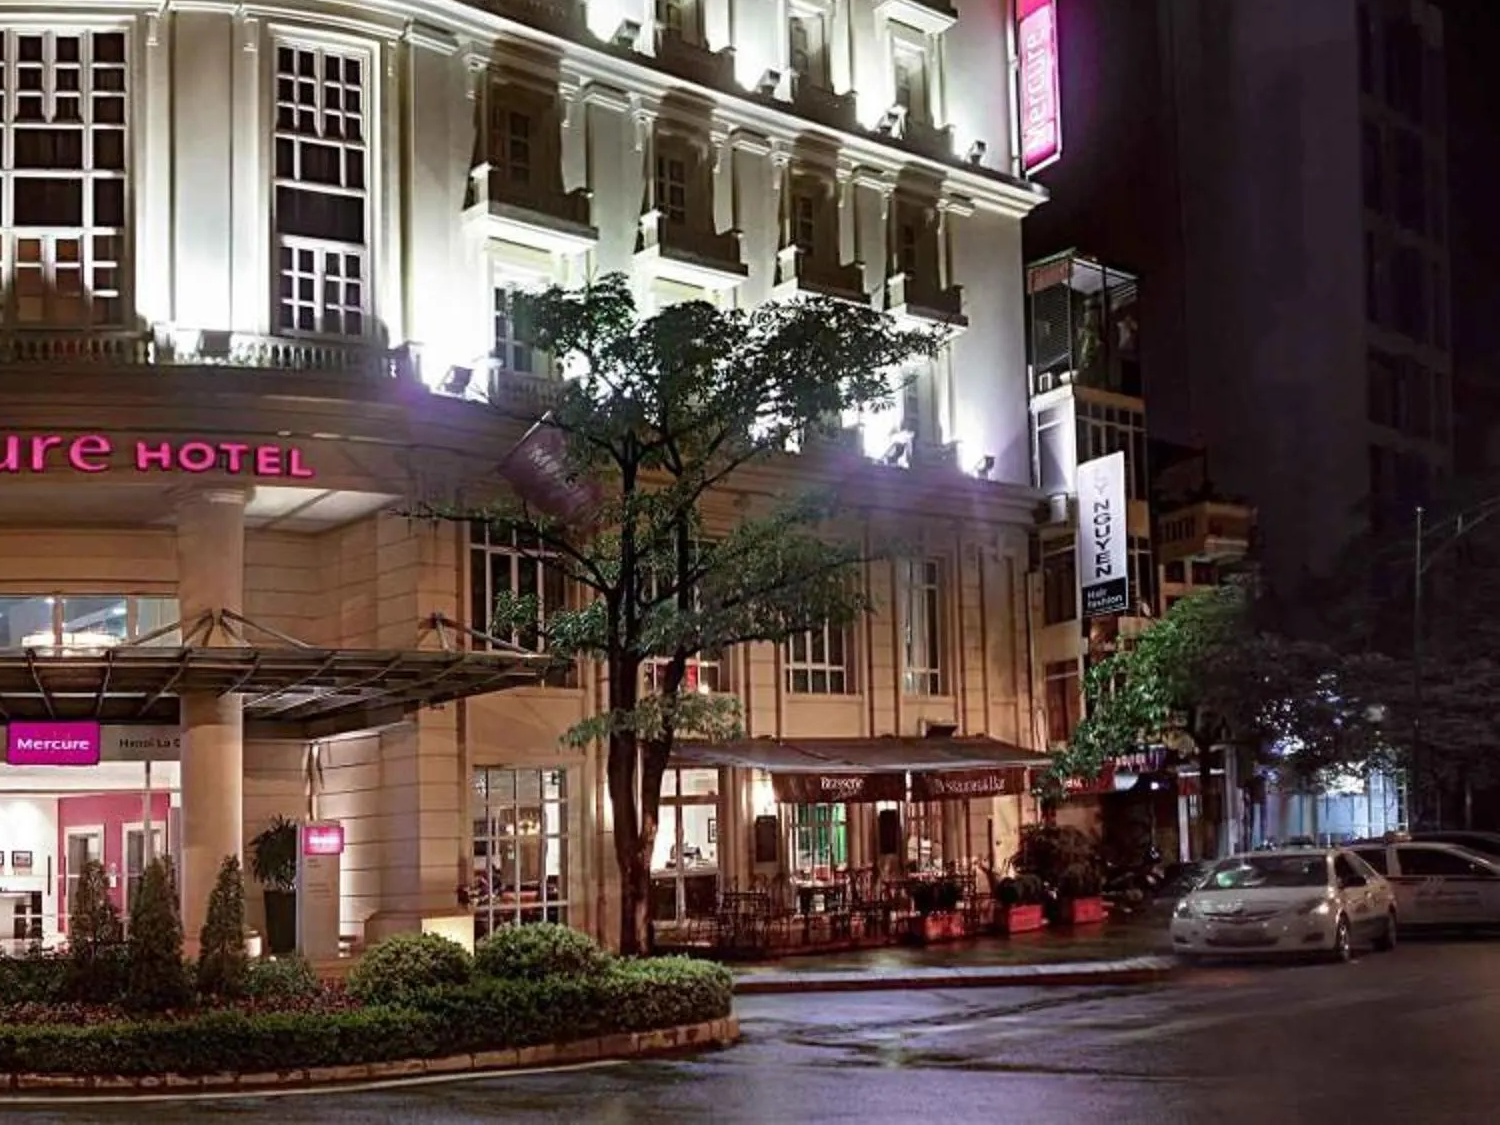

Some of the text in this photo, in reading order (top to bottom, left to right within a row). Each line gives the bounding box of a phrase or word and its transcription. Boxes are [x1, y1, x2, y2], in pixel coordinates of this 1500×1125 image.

[135, 440, 315, 478] HOTEL
[1093, 499, 1112, 578] NGUYEN
[16, 737, 90, 751] Mercure
